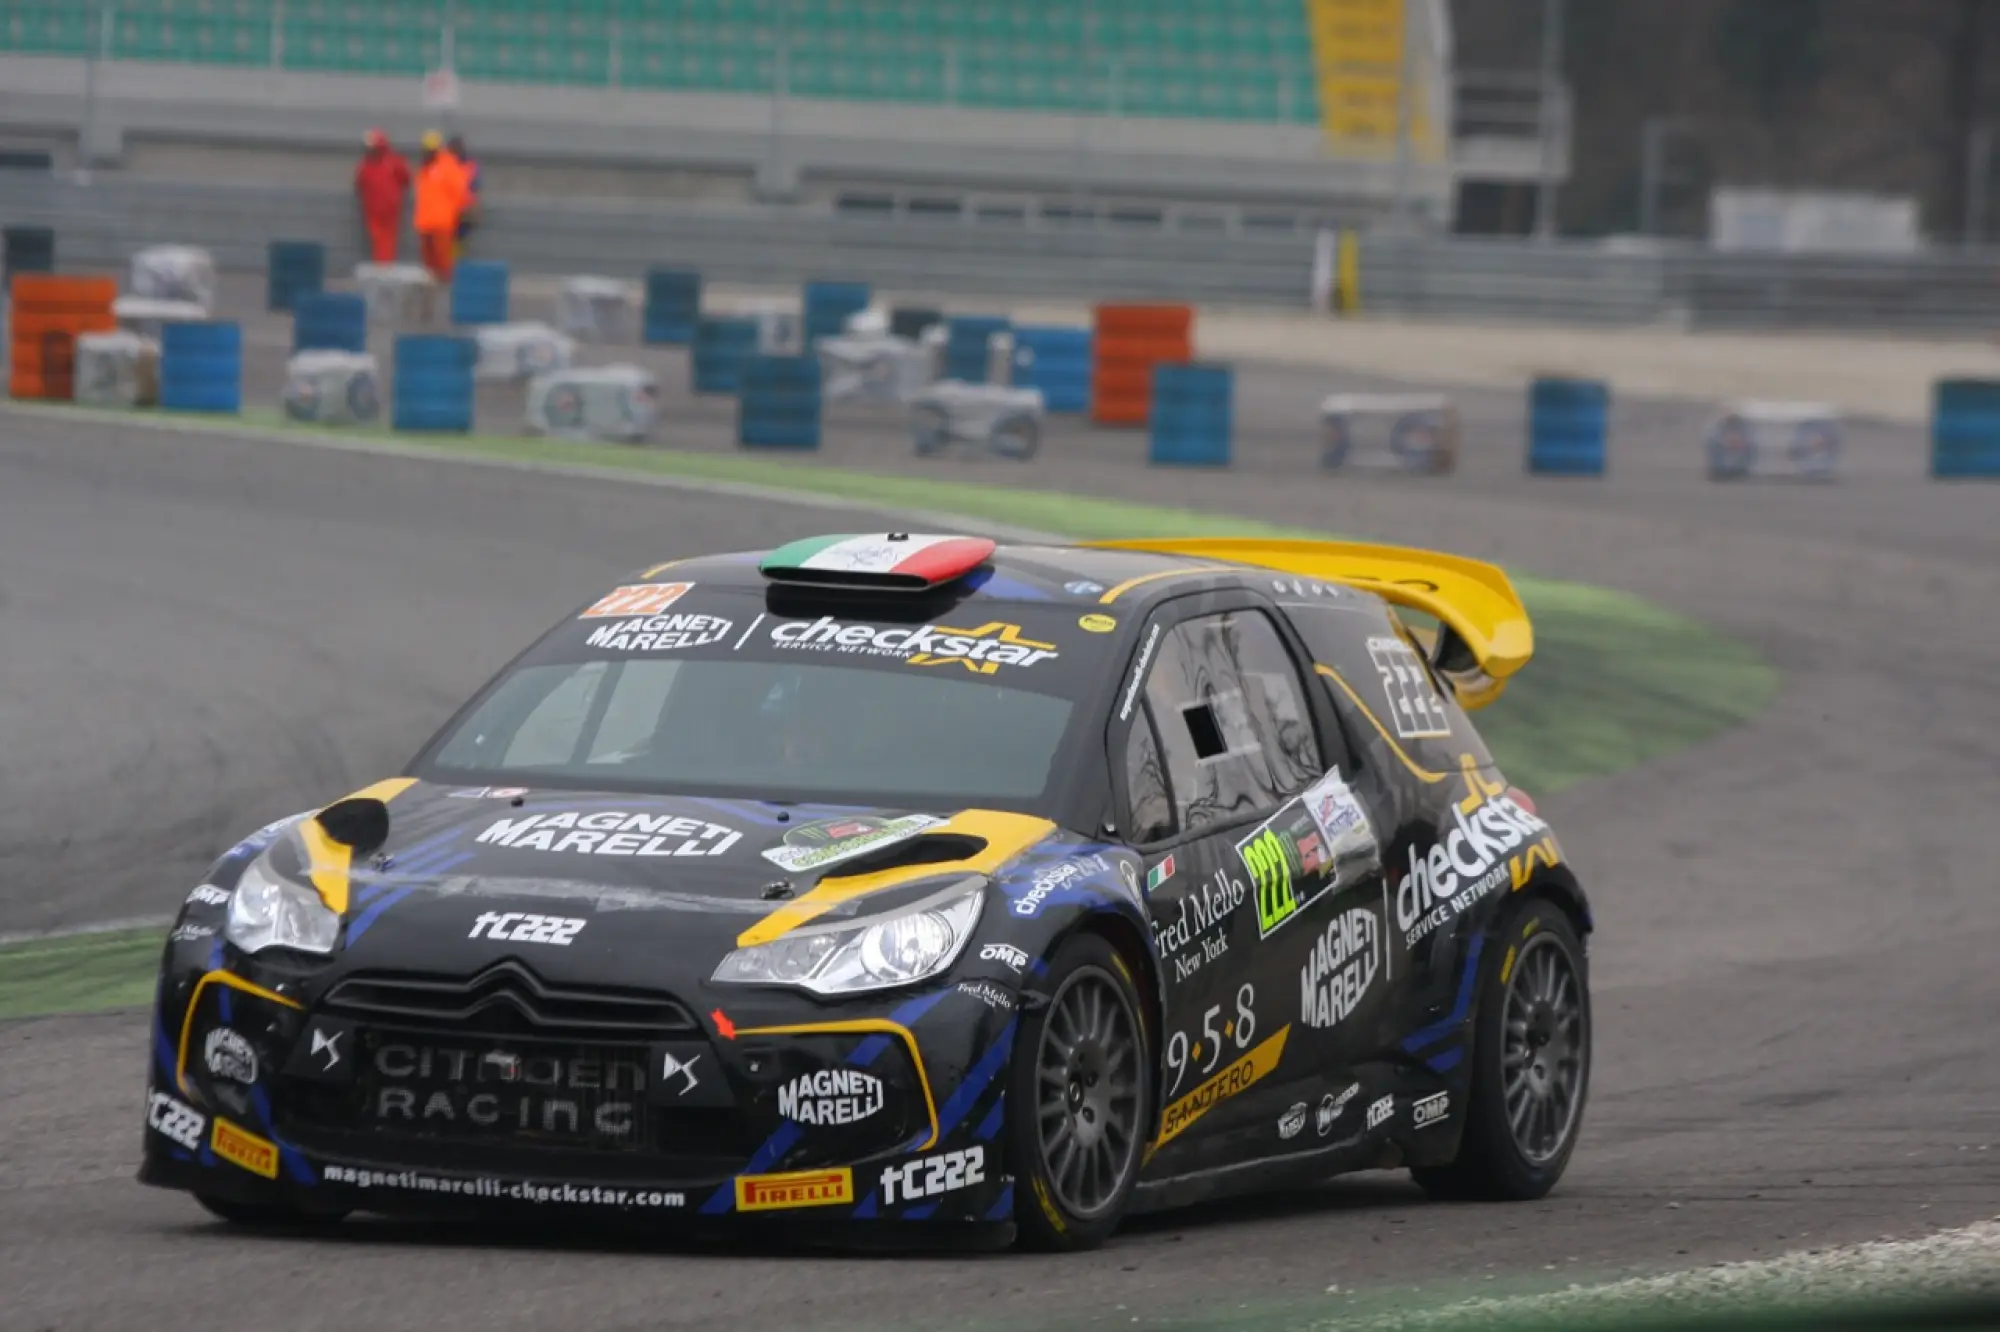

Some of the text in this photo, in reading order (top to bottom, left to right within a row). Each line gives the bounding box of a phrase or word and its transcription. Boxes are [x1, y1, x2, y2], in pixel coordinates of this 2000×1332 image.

[586, 624, 733, 650] MARELLI
[588, 614, 733, 640] MAGNETI
[770, 616, 1059, 667] checkstar
[838, 645, 917, 659] NETWORK
[475, 820, 744, 856] MARELLI
[478, 811, 744, 846] MAGNETI
[1243, 829, 1297, 931] 222
[1189, 867, 1245, 936] Mello
[1405, 861, 1510, 951] SERVICE NETWORK
[980, 947, 1026, 968] OMP
[1174, 926, 1229, 983] New York
[1303, 907, 1378, 1000] MAGNETI
[1301, 948, 1378, 1028] MARELLI
[778, 1069, 883, 1107] MAGNETI
[778, 1084, 883, 1125] MARELLI
[325, 1166, 685, 1206] magnetimarelli-checkstar.com
[744, 1174, 843, 1204] PIRELLI
